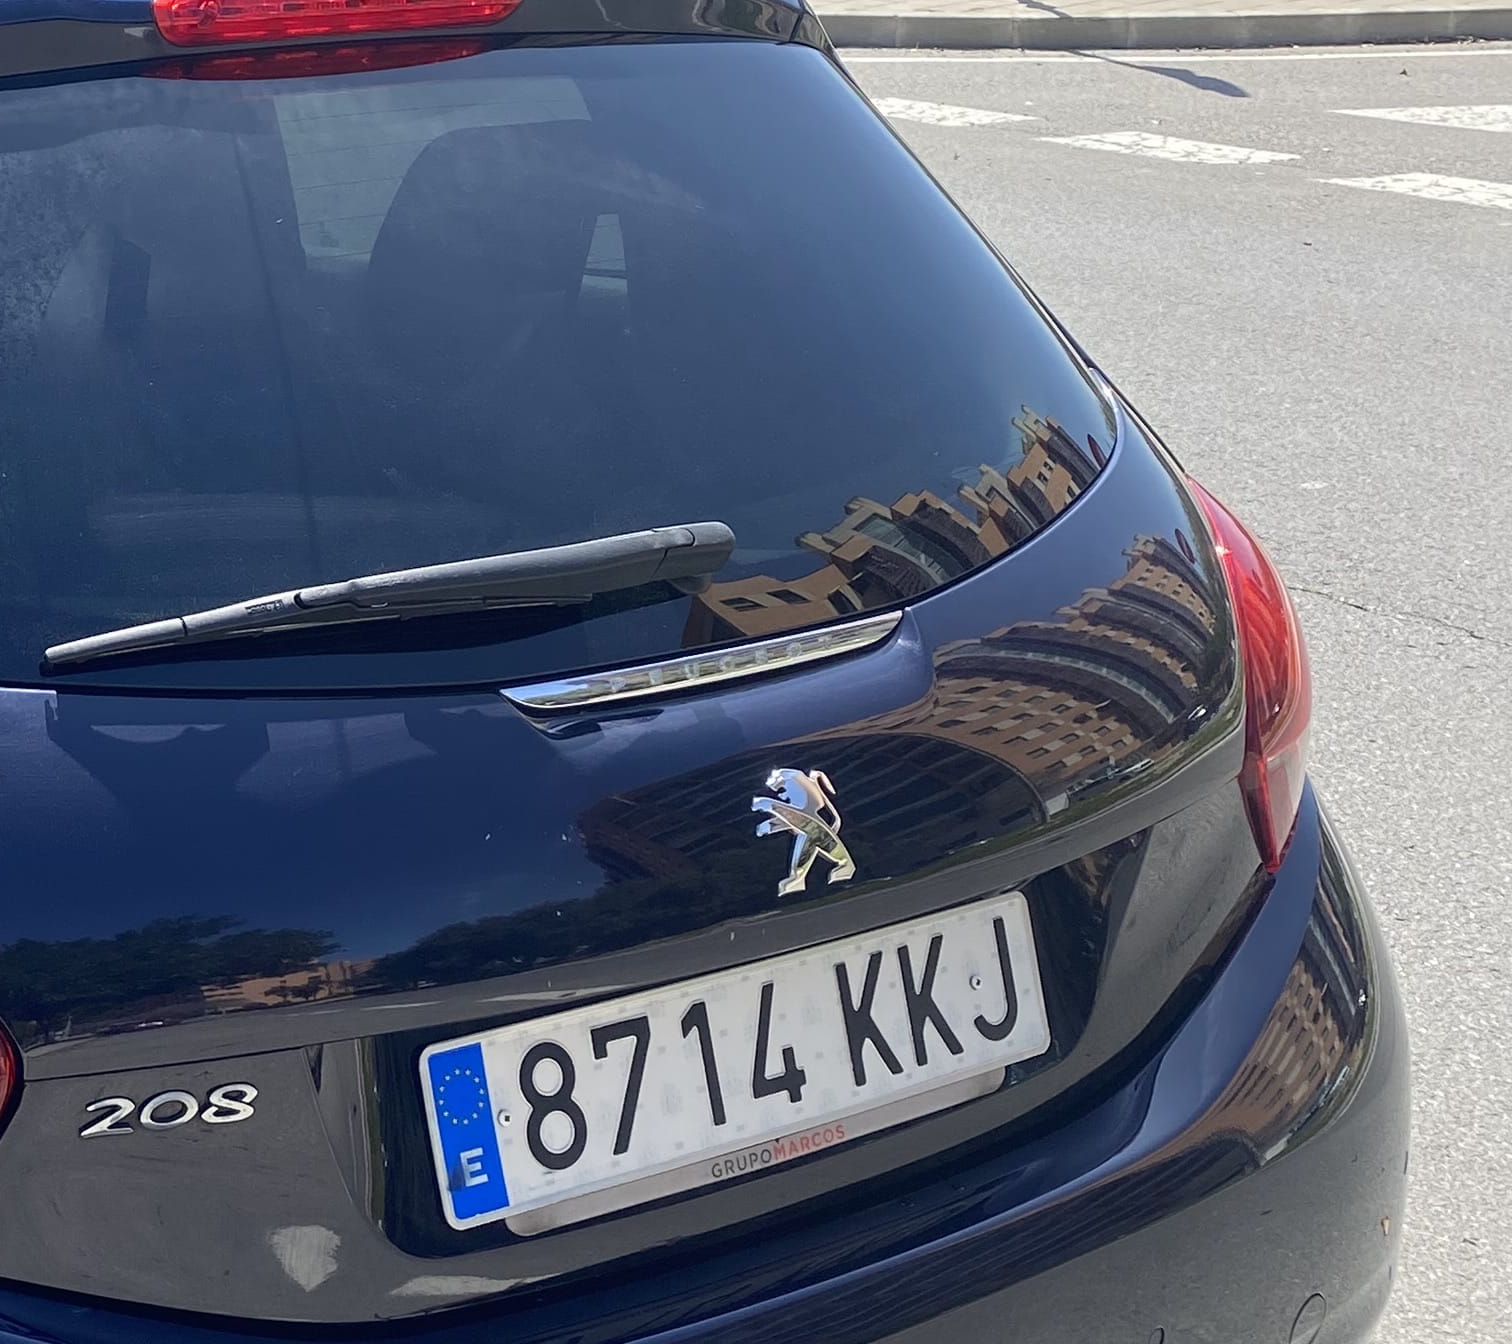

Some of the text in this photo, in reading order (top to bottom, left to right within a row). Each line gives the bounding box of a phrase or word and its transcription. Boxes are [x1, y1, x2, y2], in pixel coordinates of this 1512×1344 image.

[518, 916, 1019, 1171] 8714 KKJ
[79, 1081, 259, 1139] 208
[460, 1147, 489, 1187] E
